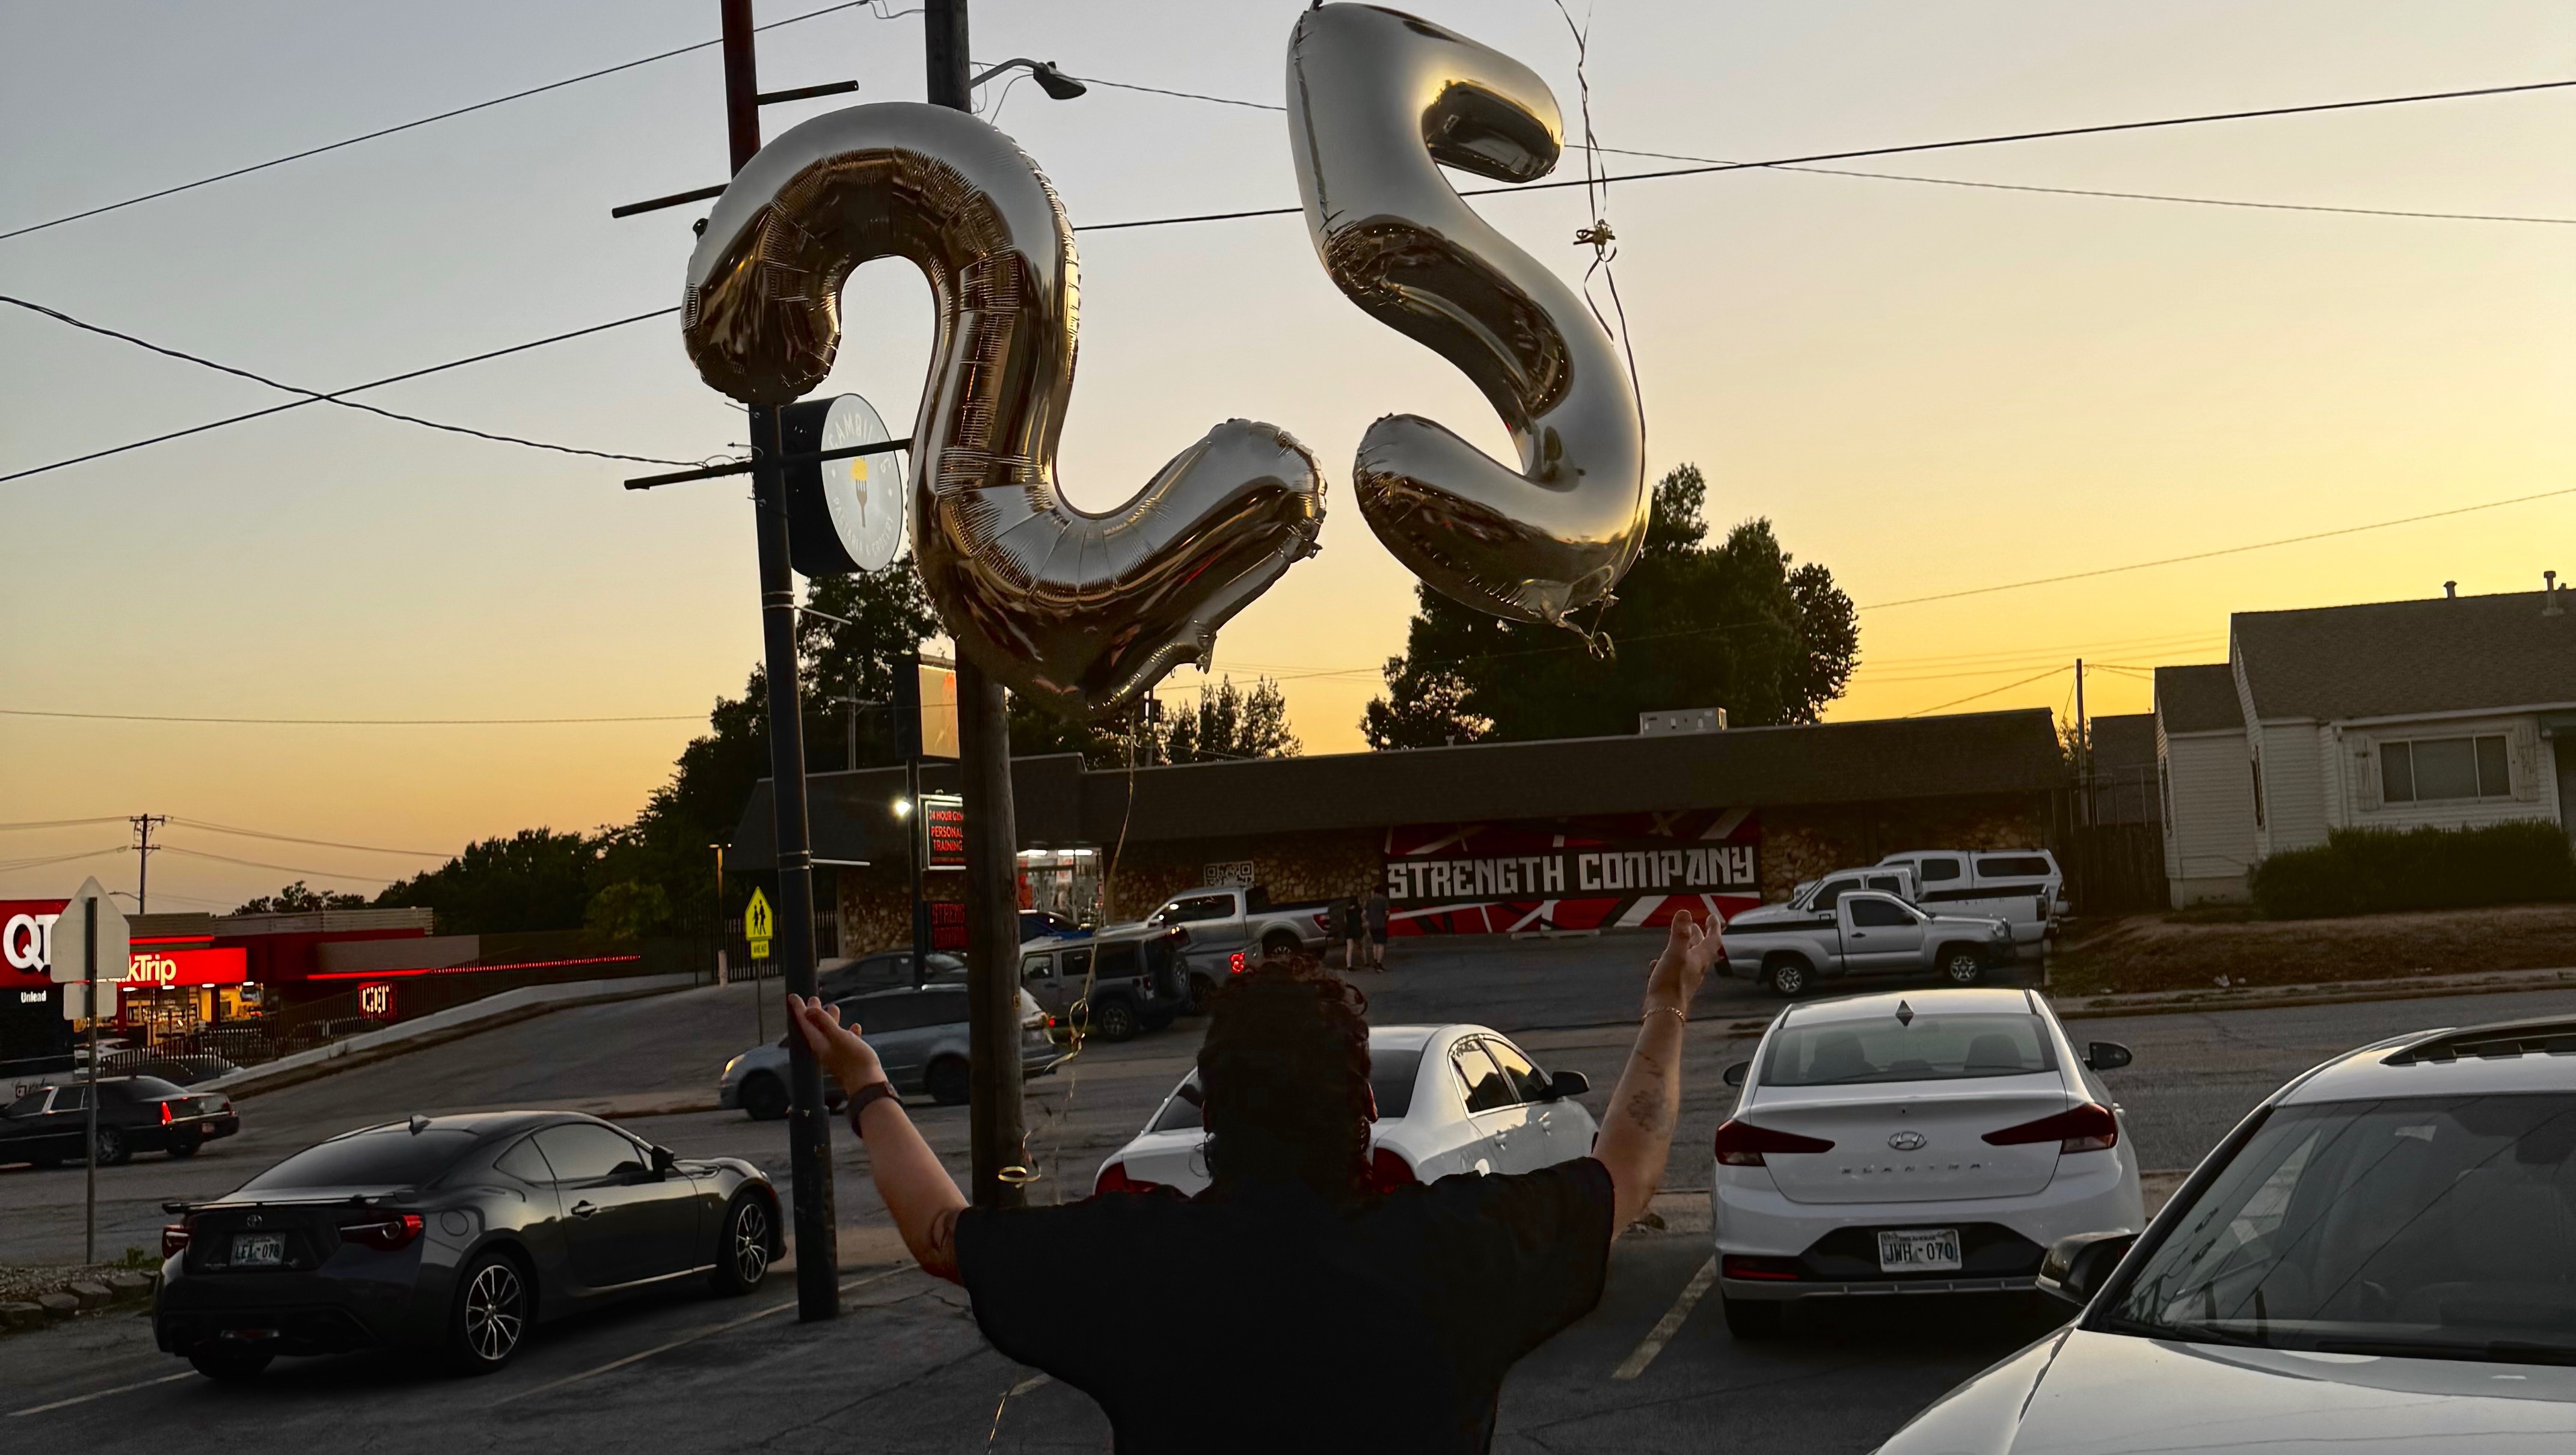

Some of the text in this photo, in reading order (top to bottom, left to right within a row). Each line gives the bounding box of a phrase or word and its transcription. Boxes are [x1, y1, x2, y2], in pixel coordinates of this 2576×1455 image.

[936, 810, 952, 821] HOUR
[931, 826, 963, 838] PERSONAL
[933, 839, 963, 851] TRAINING
[1387, 845, 1755, 899] STRENGTH COMPANY
[3, 914, 60, 972] QT
[753, 943, 767, 954] AHEAD
[20, 990, 47, 1003] Unlead
